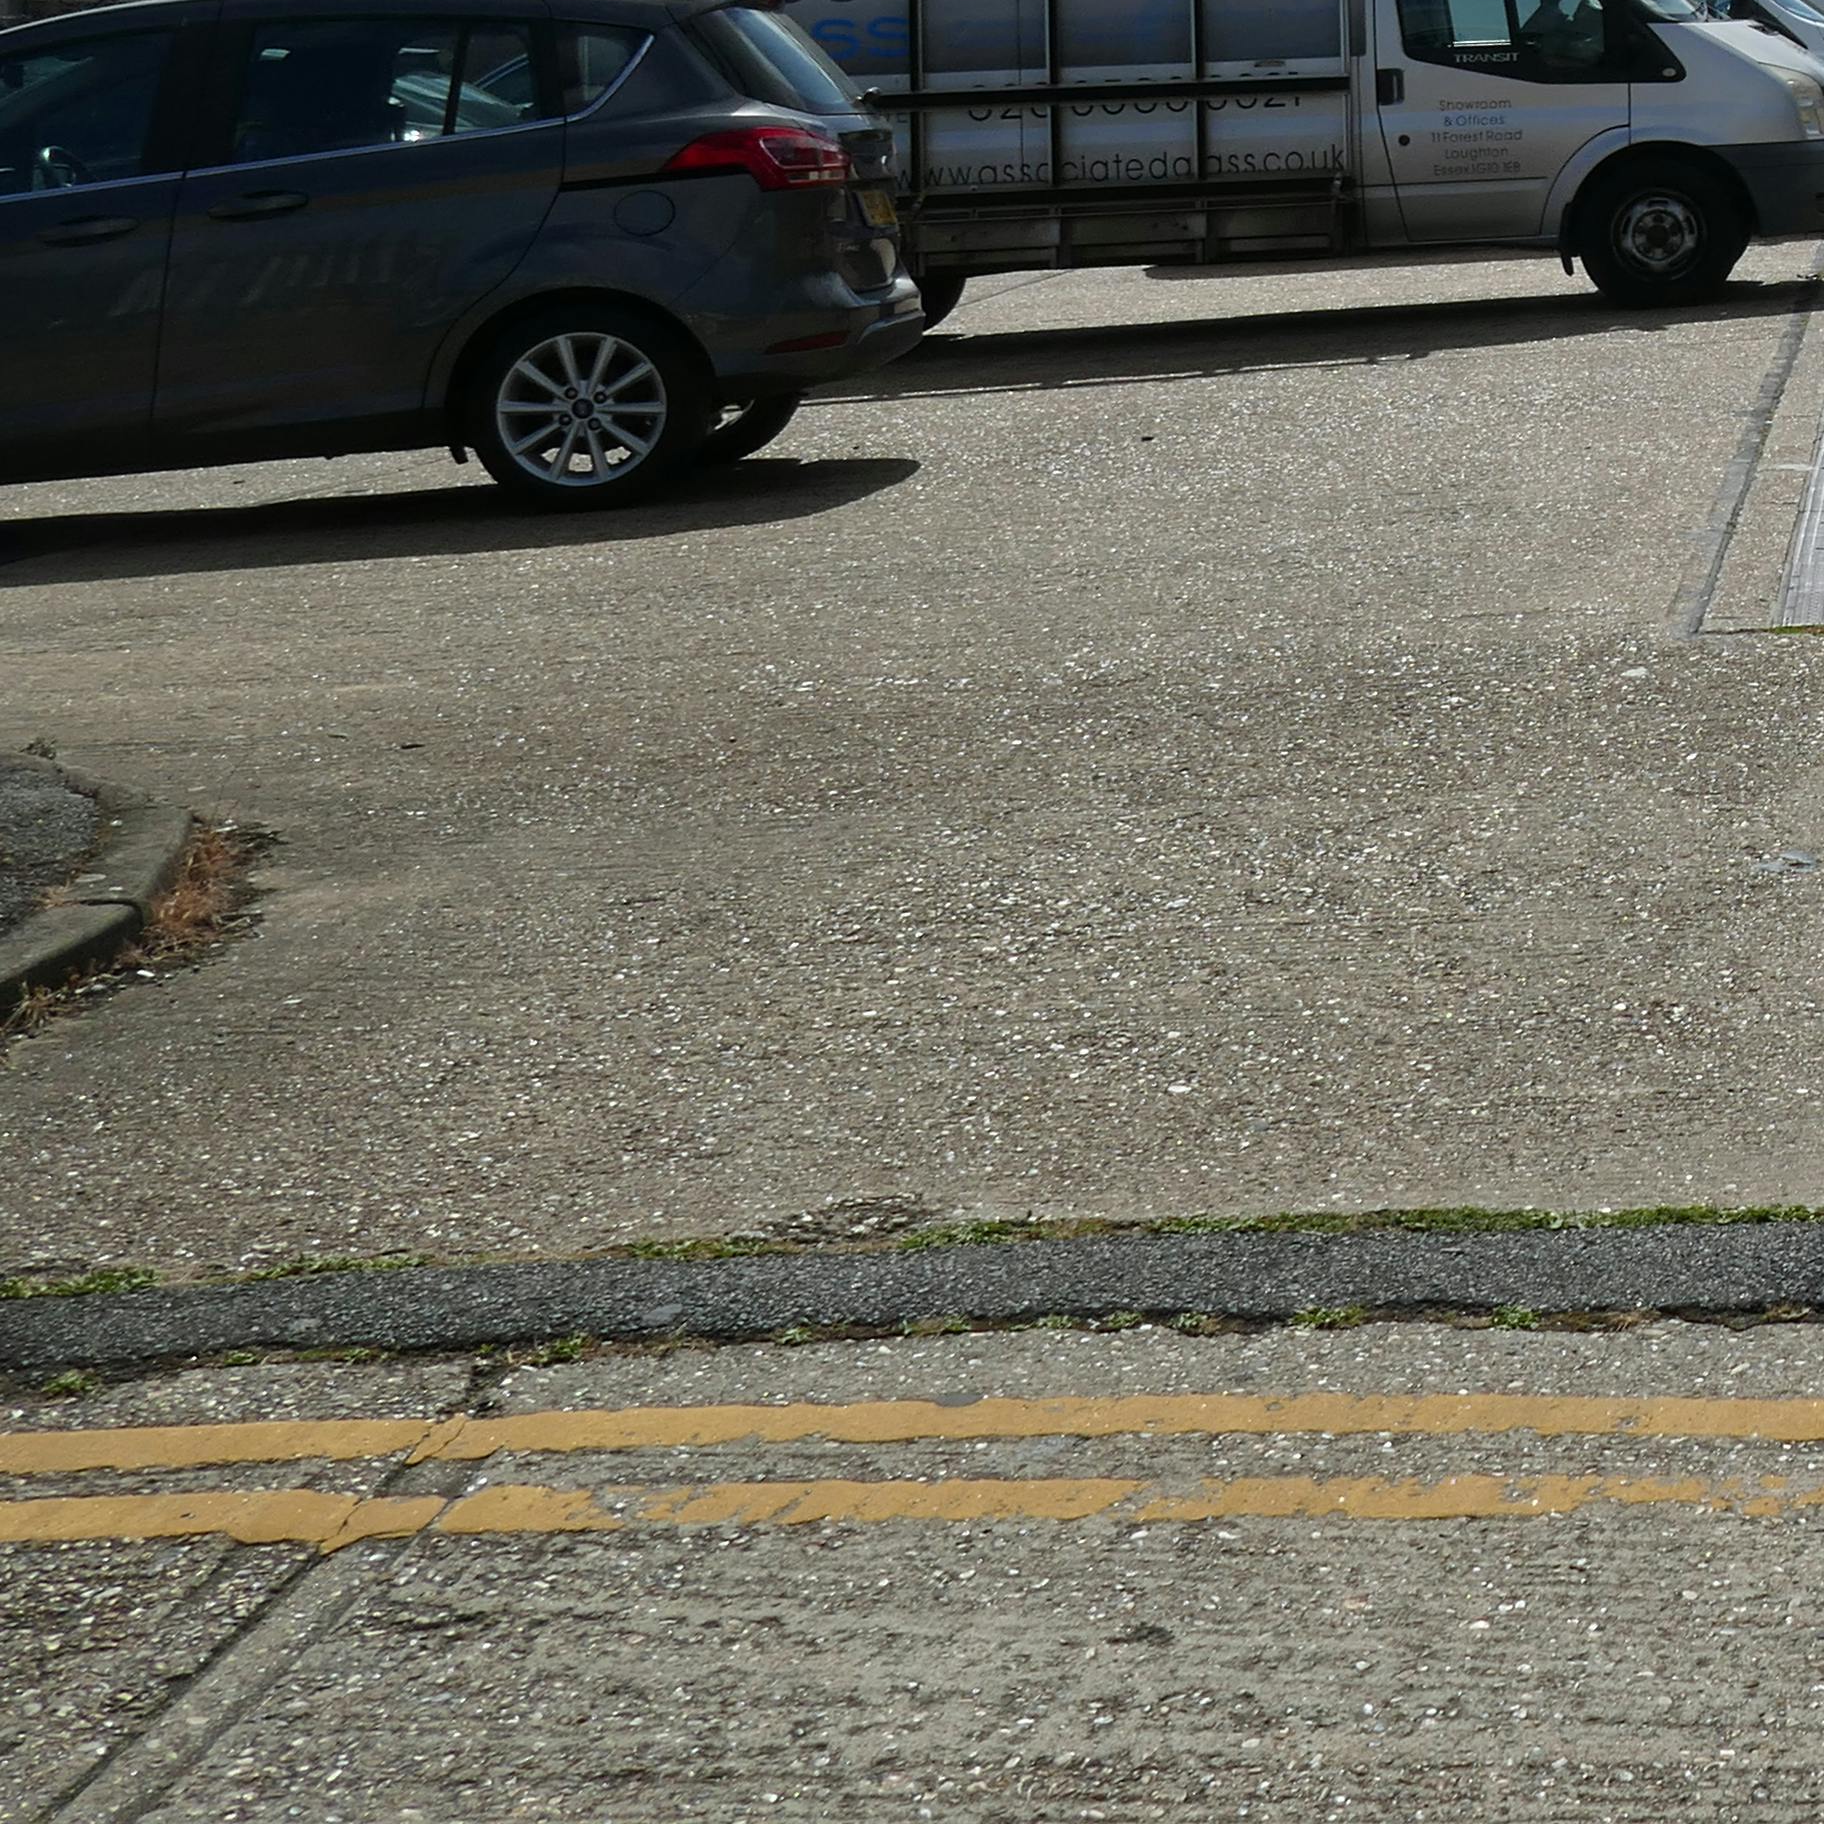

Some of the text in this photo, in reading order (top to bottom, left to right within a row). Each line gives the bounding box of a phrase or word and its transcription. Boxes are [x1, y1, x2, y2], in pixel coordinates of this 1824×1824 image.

[1453, 52, 1521, 63] TRANSIT
[1438, 98, 1512, 112] Showroom
[1443, 114, 1505, 127] & Offices
[1442, 131, 1483, 143] Forest
[1486, 129, 1523, 141] Road
[1445, 146, 1509, 161] Loughton
